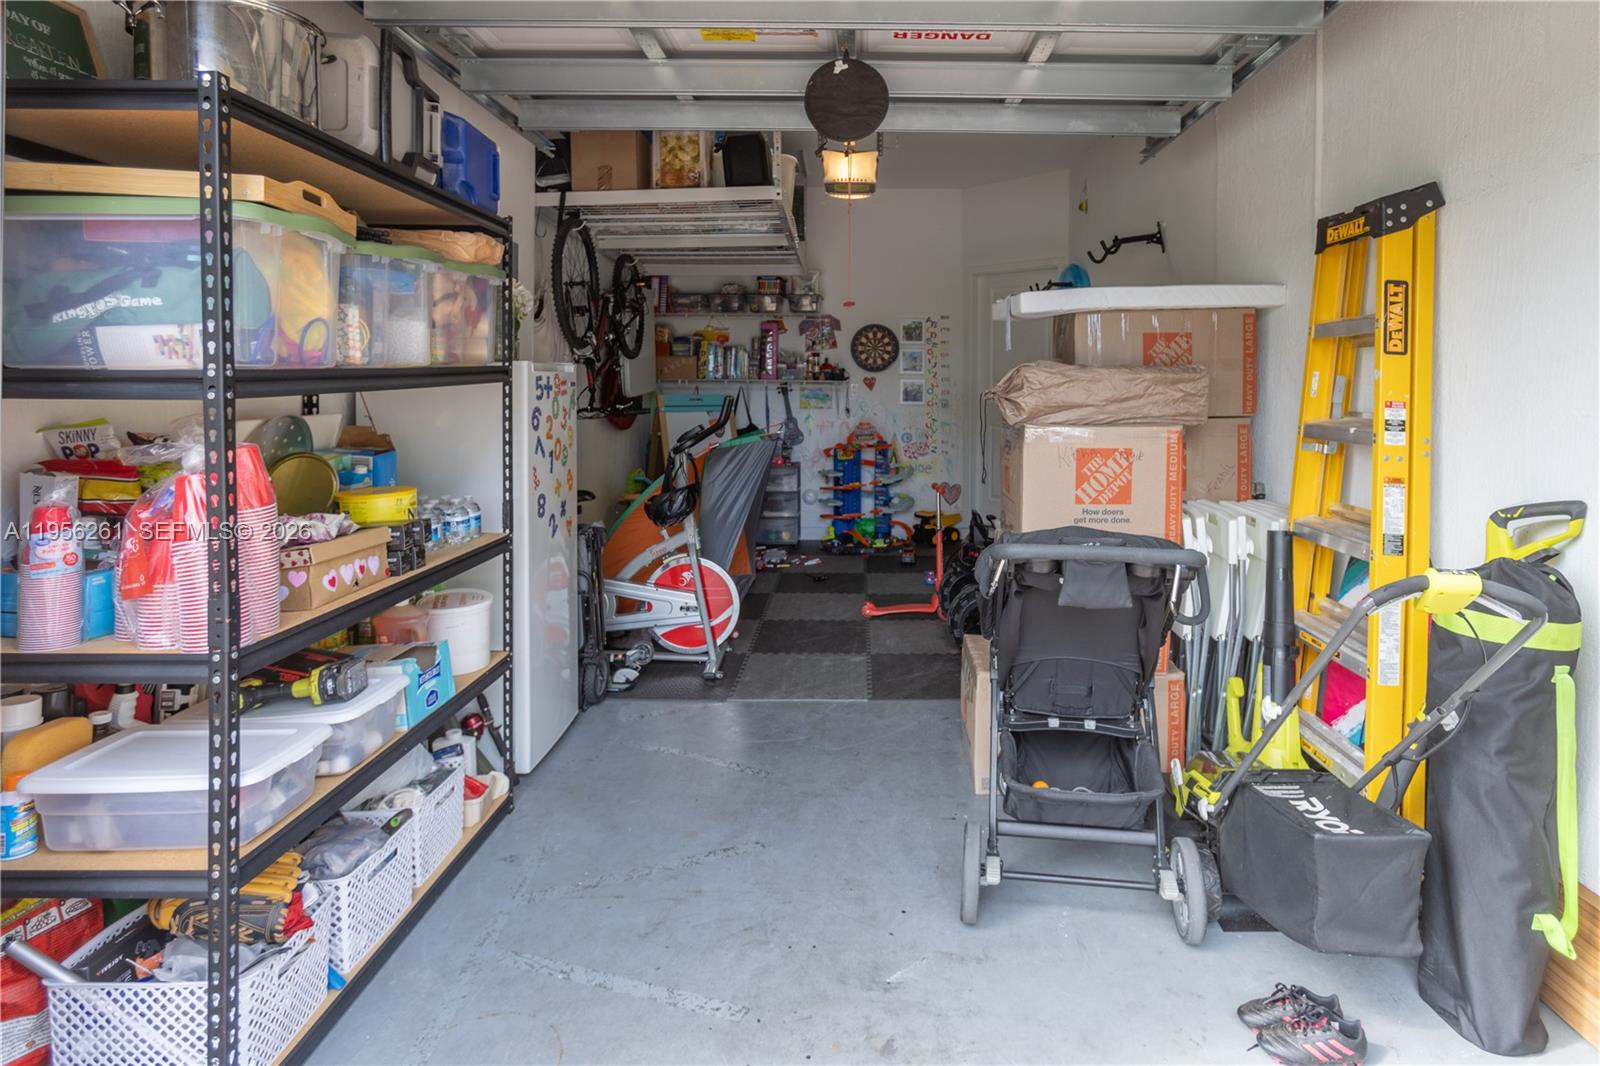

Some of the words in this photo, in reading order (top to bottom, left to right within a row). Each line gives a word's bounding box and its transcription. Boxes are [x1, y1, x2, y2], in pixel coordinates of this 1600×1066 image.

[892, 31, 993, 41] DANGER
[1327, 216, 1366, 244] DEWALT
[119, 294, 164, 308] Game
[1387, 283, 1405, 353] DEWALT
[1246, 317, 1254, 353] LARGE
[1246, 358, 1254, 381] DUTY
[61, 443, 100, 460] POP
[1169, 433, 1178, 480] MEDIUM
[1240, 428, 1248, 464] LARGE
[1075, 447, 1133, 504] HOME
[1081, 453, 1106, 478] THE
[1098, 467, 1133, 506] DEPOT
[1169, 485, 1178, 510] DUTY
[1073, 517, 1088, 525] get
[1081, 508, 1100, 516] How
[1101, 508, 1124, 516] doers
[1170, 683, 1181, 725] LARGE
[1170, 730, 1180, 757] DUTY
